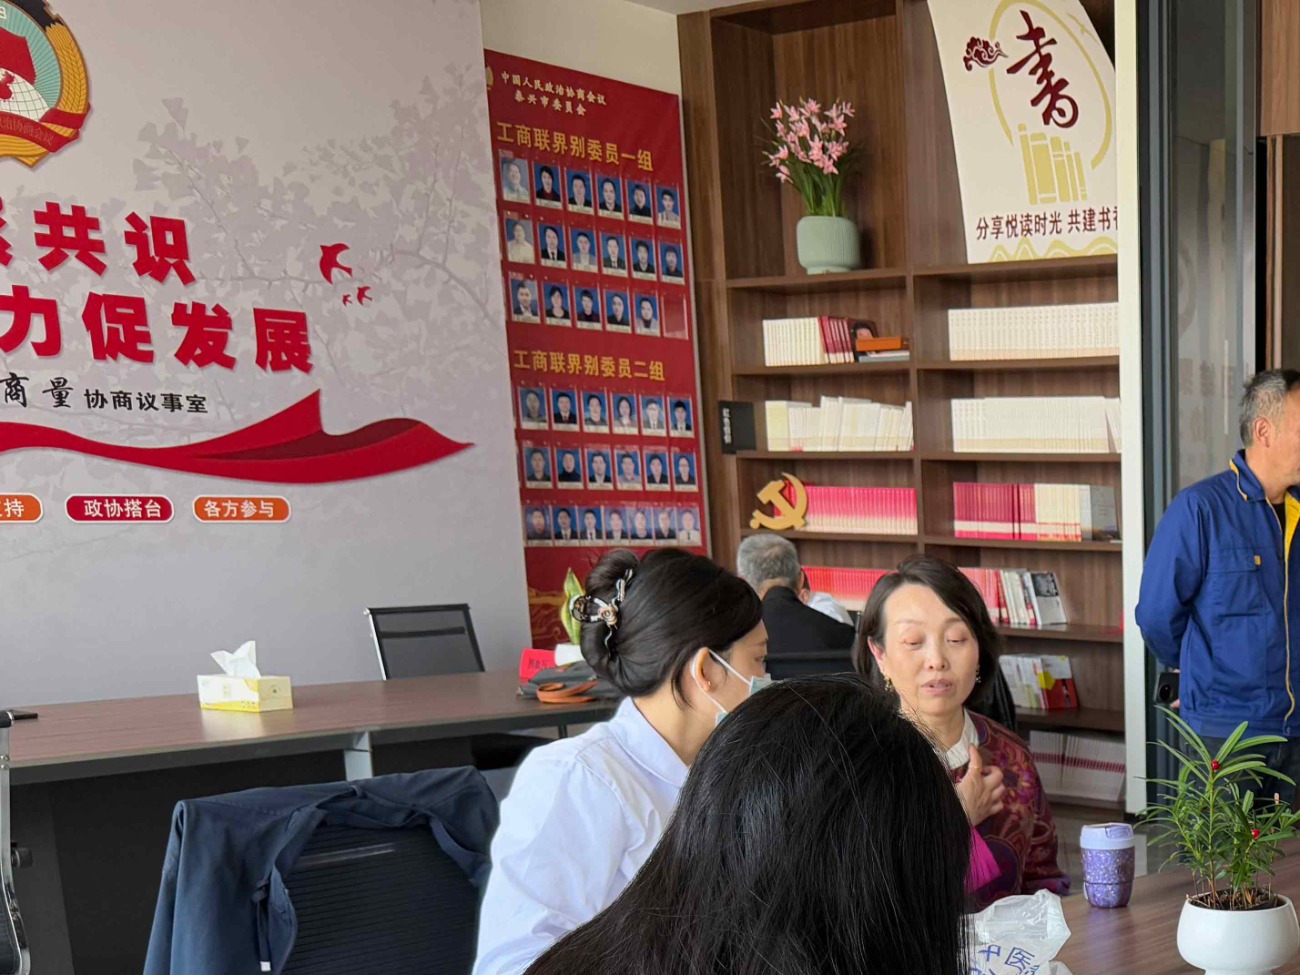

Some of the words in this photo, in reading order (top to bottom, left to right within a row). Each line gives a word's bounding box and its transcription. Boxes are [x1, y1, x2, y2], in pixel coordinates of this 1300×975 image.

[501, 70, 607, 106] 中国人民政治协商会议
[496, 121, 654, 172] 工商联界别委员一组
[976, 210, 1062, 240] 分享悦读时光
[0, 197, 196, 286] 共识
[513, 350, 666, 382] 工商联界别委员二组
[84, 388, 208, 413] 协商议事室
[0, 498, 25, 518] 持
[83, 498, 163, 519] 政协搭台
[203, 500, 275, 519] 各方参与
